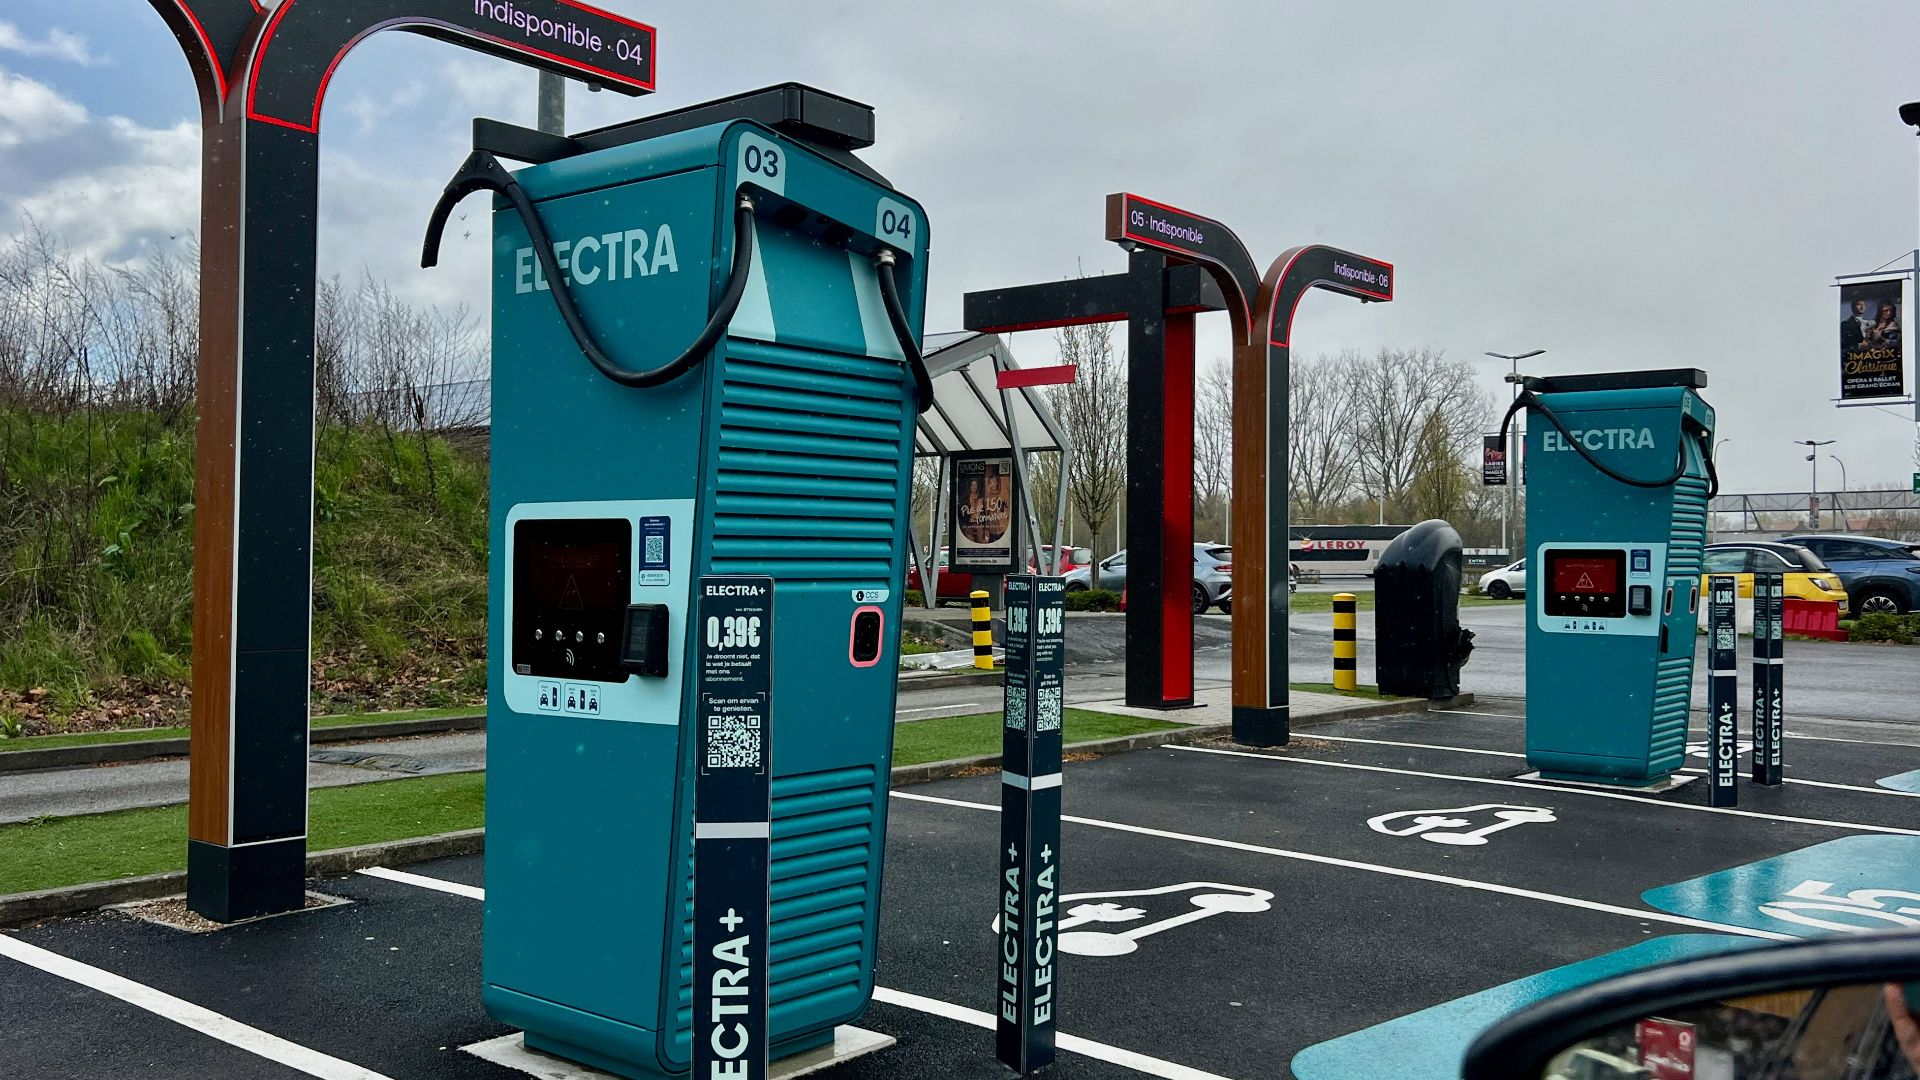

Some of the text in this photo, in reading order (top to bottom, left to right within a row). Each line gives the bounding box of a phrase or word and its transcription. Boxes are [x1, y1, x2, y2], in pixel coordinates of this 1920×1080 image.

[474, 0, 643, 65] Indisponible 04
[744, 144, 779, 178] 03
[882, 209, 912, 239] 04
[1131, 210, 1203, 244] 05 Indisponible
[515, 223, 679, 295] ELECTRA
[1333, 261, 1389, 288] Indisponible 06
[1845, 360, 1897, 376] Classique
[1848, 348, 1895, 361] IMAGIX
[1543, 427, 1655, 452] ELECTRA
[1317, 541, 1365, 549] LEROY
[706, 585, 766, 596] ELECTRA+
[865, 591, 879, 599] CCS
[1008, 581, 1031, 591] ELECTRA+
[1038, 582, 1065, 592] ELECTRA+
[707, 616, 761, 651] 0,39€
[1038, 607, 1062, 637] 0,39€
[1755, 688, 1765, 765] ELECTRA+
[1771, 688, 1781, 766] ELECTRA+
[1719, 702, 1734, 787] ELECTRA+
[1002, 842, 1021, 1025] ELECTRA+
[1034, 843, 1055, 1026] ELECTRA+
[711, 907, 750, 1080] ECTRA+
